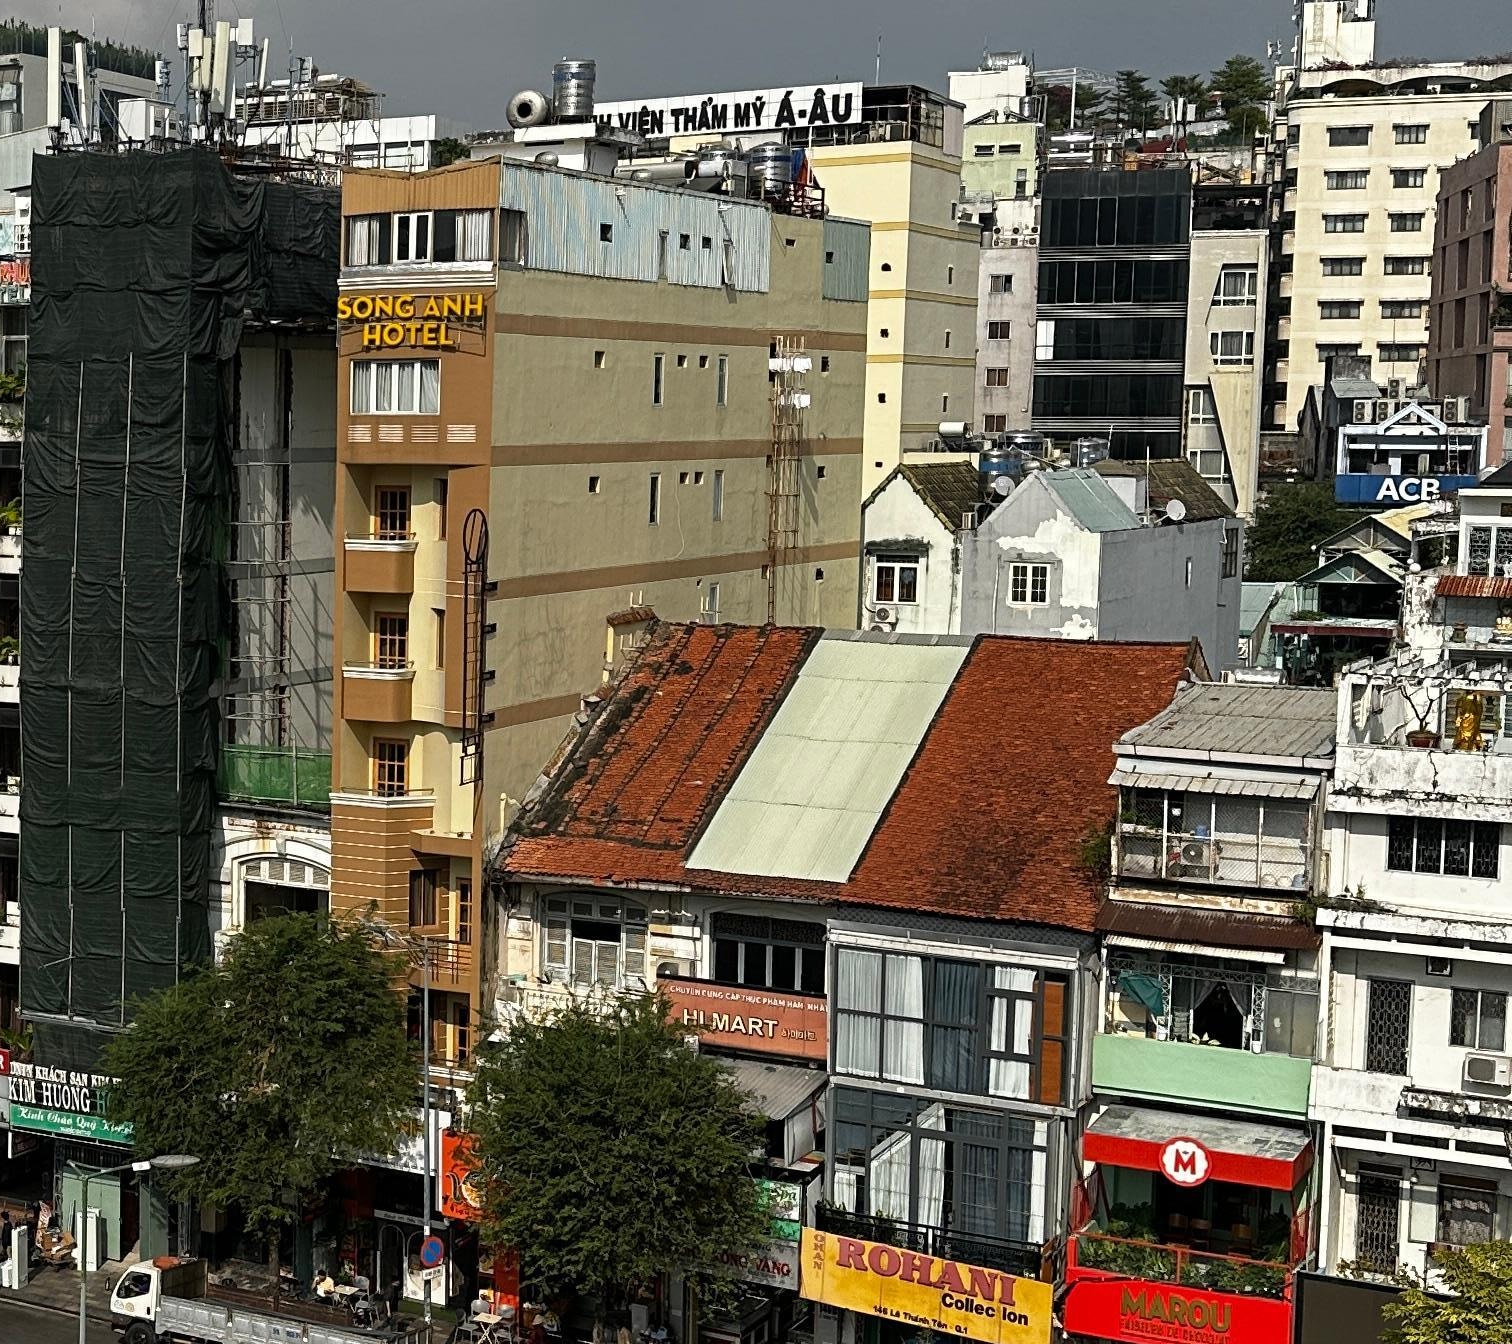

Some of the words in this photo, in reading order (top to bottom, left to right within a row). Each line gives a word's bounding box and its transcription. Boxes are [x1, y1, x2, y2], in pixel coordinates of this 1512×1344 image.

[670, 96, 728, 134] THẨM
[734, 96, 767, 128] MỸ
[337, 294, 416, 320] SONG
[423, 293, 484, 317] ANH
[362, 323, 455, 347] HOTEL
[1375, 477, 1441, 501] ACB
[682, 1008, 705, 1026] HI
[712, 1012, 778, 1038] MART
[34, 1065, 67, 1084] KHÁCH
[8, 1076, 37, 1104] KIM
[41, 1082, 91, 1113] HUONG
[1174, 1148, 1196, 1175] M
[836, 1237, 1017, 1306] ROHANI
[1120, 1286, 1232, 1334] MAROU
